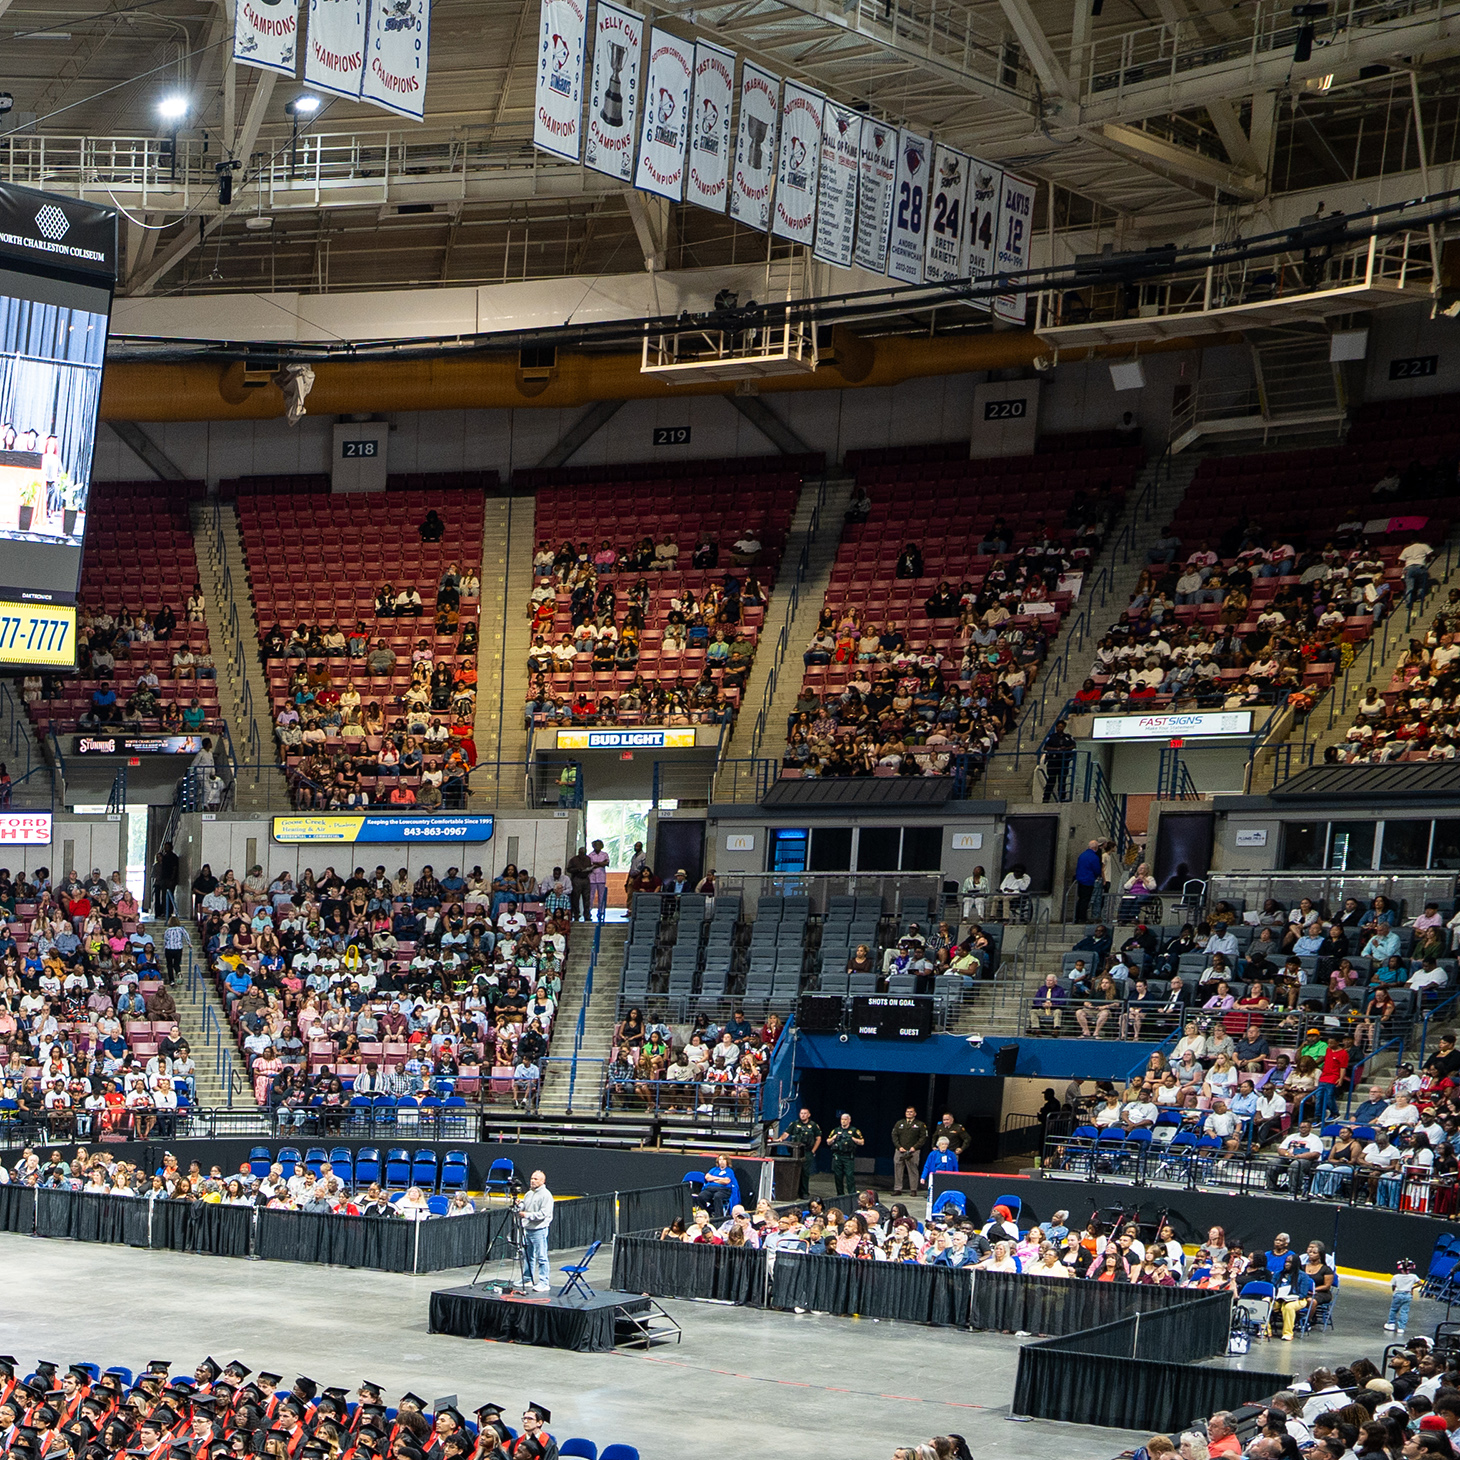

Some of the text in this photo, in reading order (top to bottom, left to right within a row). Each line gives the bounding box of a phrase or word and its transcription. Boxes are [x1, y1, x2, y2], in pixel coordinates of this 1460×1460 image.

[243, 3, 296, 36] CHAMPIONS
[599, 17, 623, 33] KELLY
[312, 39, 362, 72] CHAMPIONS
[540, 23, 549, 87] 1997
[372, 57, 419, 93] CHAMPIONS
[573, 37, 582, 102] 1998
[711, 58, 732, 91] DIVISION
[628, 62, 636, 121] 1997
[538, 106, 576, 137] CHAMPIONS
[679, 88, 688, 154] 1997
[591, 120, 631, 151] CHAMPIONS
[737, 109, 746, 163] 1996
[822, 132, 836, 150] HALL
[643, 156, 681, 185] CHAMPIONS
[690, 168, 725, 196] CHAMPIONS
[736, 171, 769, 200] CHAMPIONS
[777, 202, 812, 230] CHAMPIONS
[897, 180, 923, 234] 28
[933, 192, 960, 239] 24
[1005, 189, 1030, 217] DAVIS
[970, 206, 992, 251] 14
[1005, 215, 1023, 256] 12
[23, 237, 69, 255] CHARLESTON
[69, 246, 105, 262] COLISEUM
[898, 238, 917, 250] ANDREW
[935, 236, 955, 252] BRETT
[969, 253, 985, 268] DAVE
[1395, 355, 1435, 379] 221
[988, 402, 1023, 418] 220
[346, 443, 374, 457] 218
[657, 429, 687, 444] 219
[1139, 716, 1204, 727] FASTSIGNS
[80, 738, 116, 753] STUNNING
[590, 733, 663, 746] BUD LIGHT
[305, 818, 326, 826] Creek
[403, 827, 467, 836] 843-863-0967
[868, 998, 888, 1006] SHOTS
[899, 999, 915, 1007] GOAL
[859, 1026, 920, 1036] HOME GUEST
